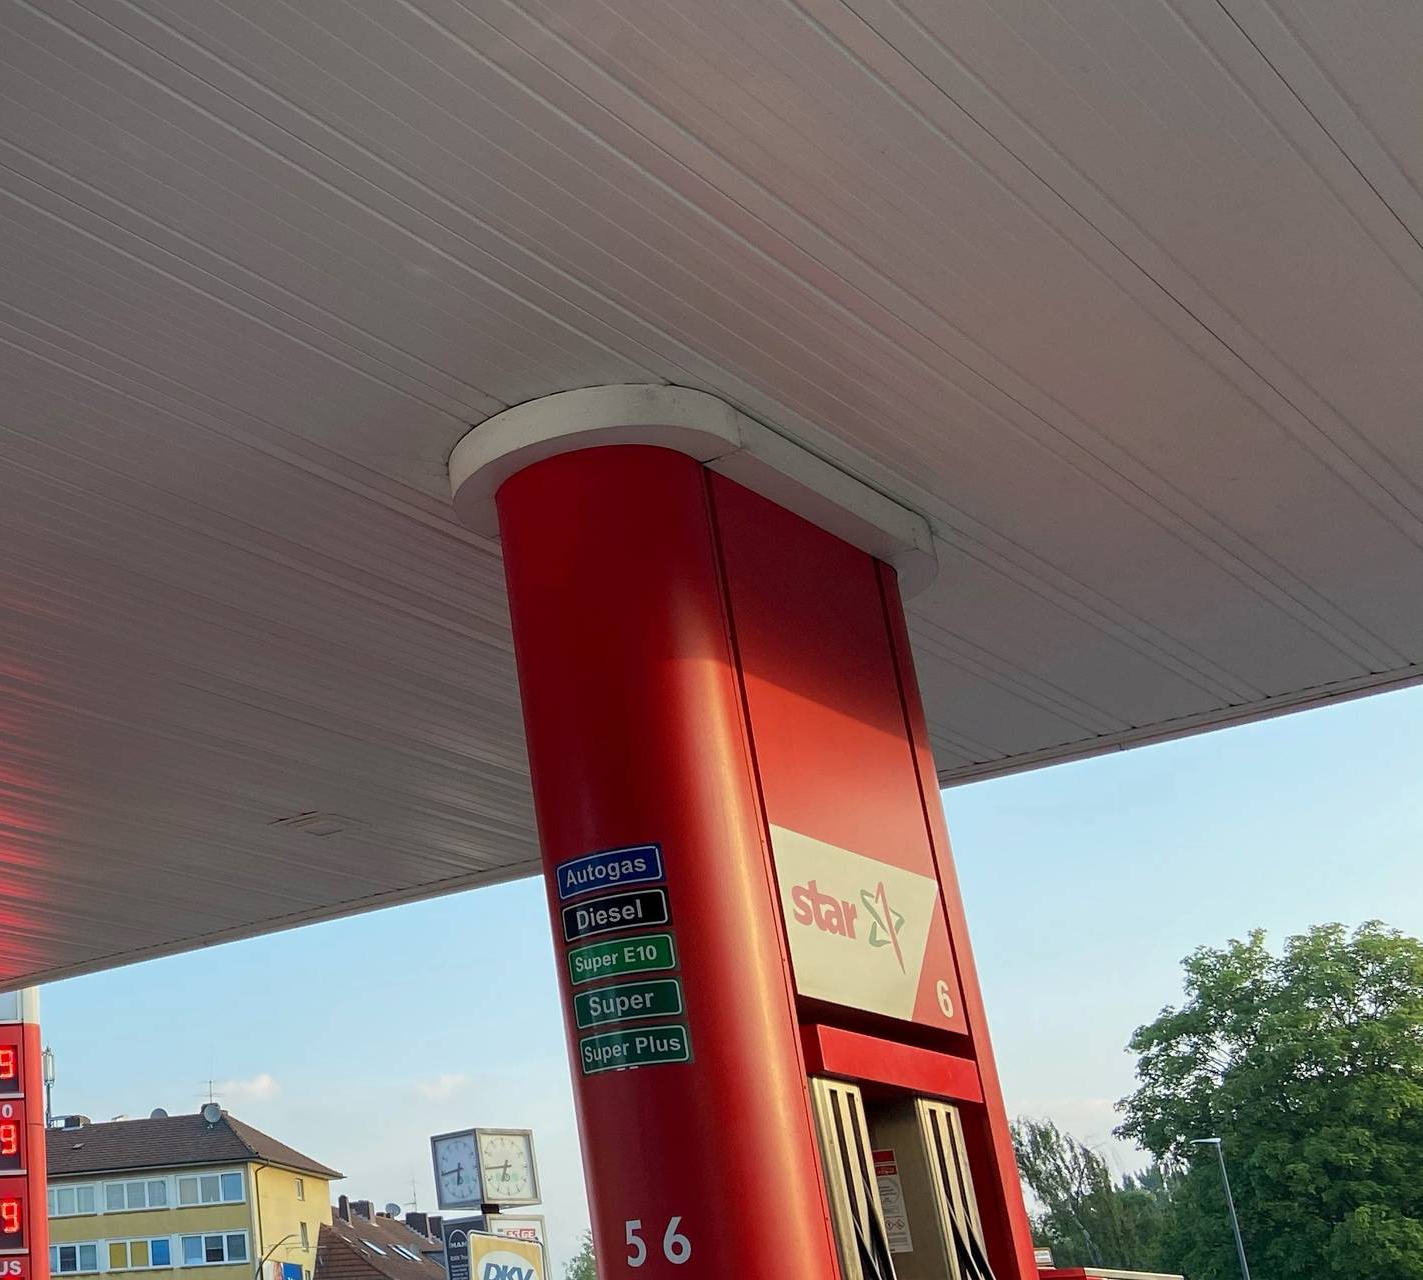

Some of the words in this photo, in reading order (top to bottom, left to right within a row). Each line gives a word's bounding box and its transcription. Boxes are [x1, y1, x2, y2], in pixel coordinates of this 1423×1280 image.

[566, 858, 647, 888] Autogas
[576, 899, 643, 930] Diesel
[791, 880, 858, 939] star
[575, 952, 619, 972] Super
[623, 945, 657, 963] E10
[589, 992, 654, 1016] Super
[936, 980, 954, 1018] 6
[584, 1043, 630, 1063] Super
[635, 1036, 681, 1055] Plus
[625, 1219, 647, 1268] 5
[663, 1216, 692, 1265] 6
[483, 1263, 534, 1280] DKV
